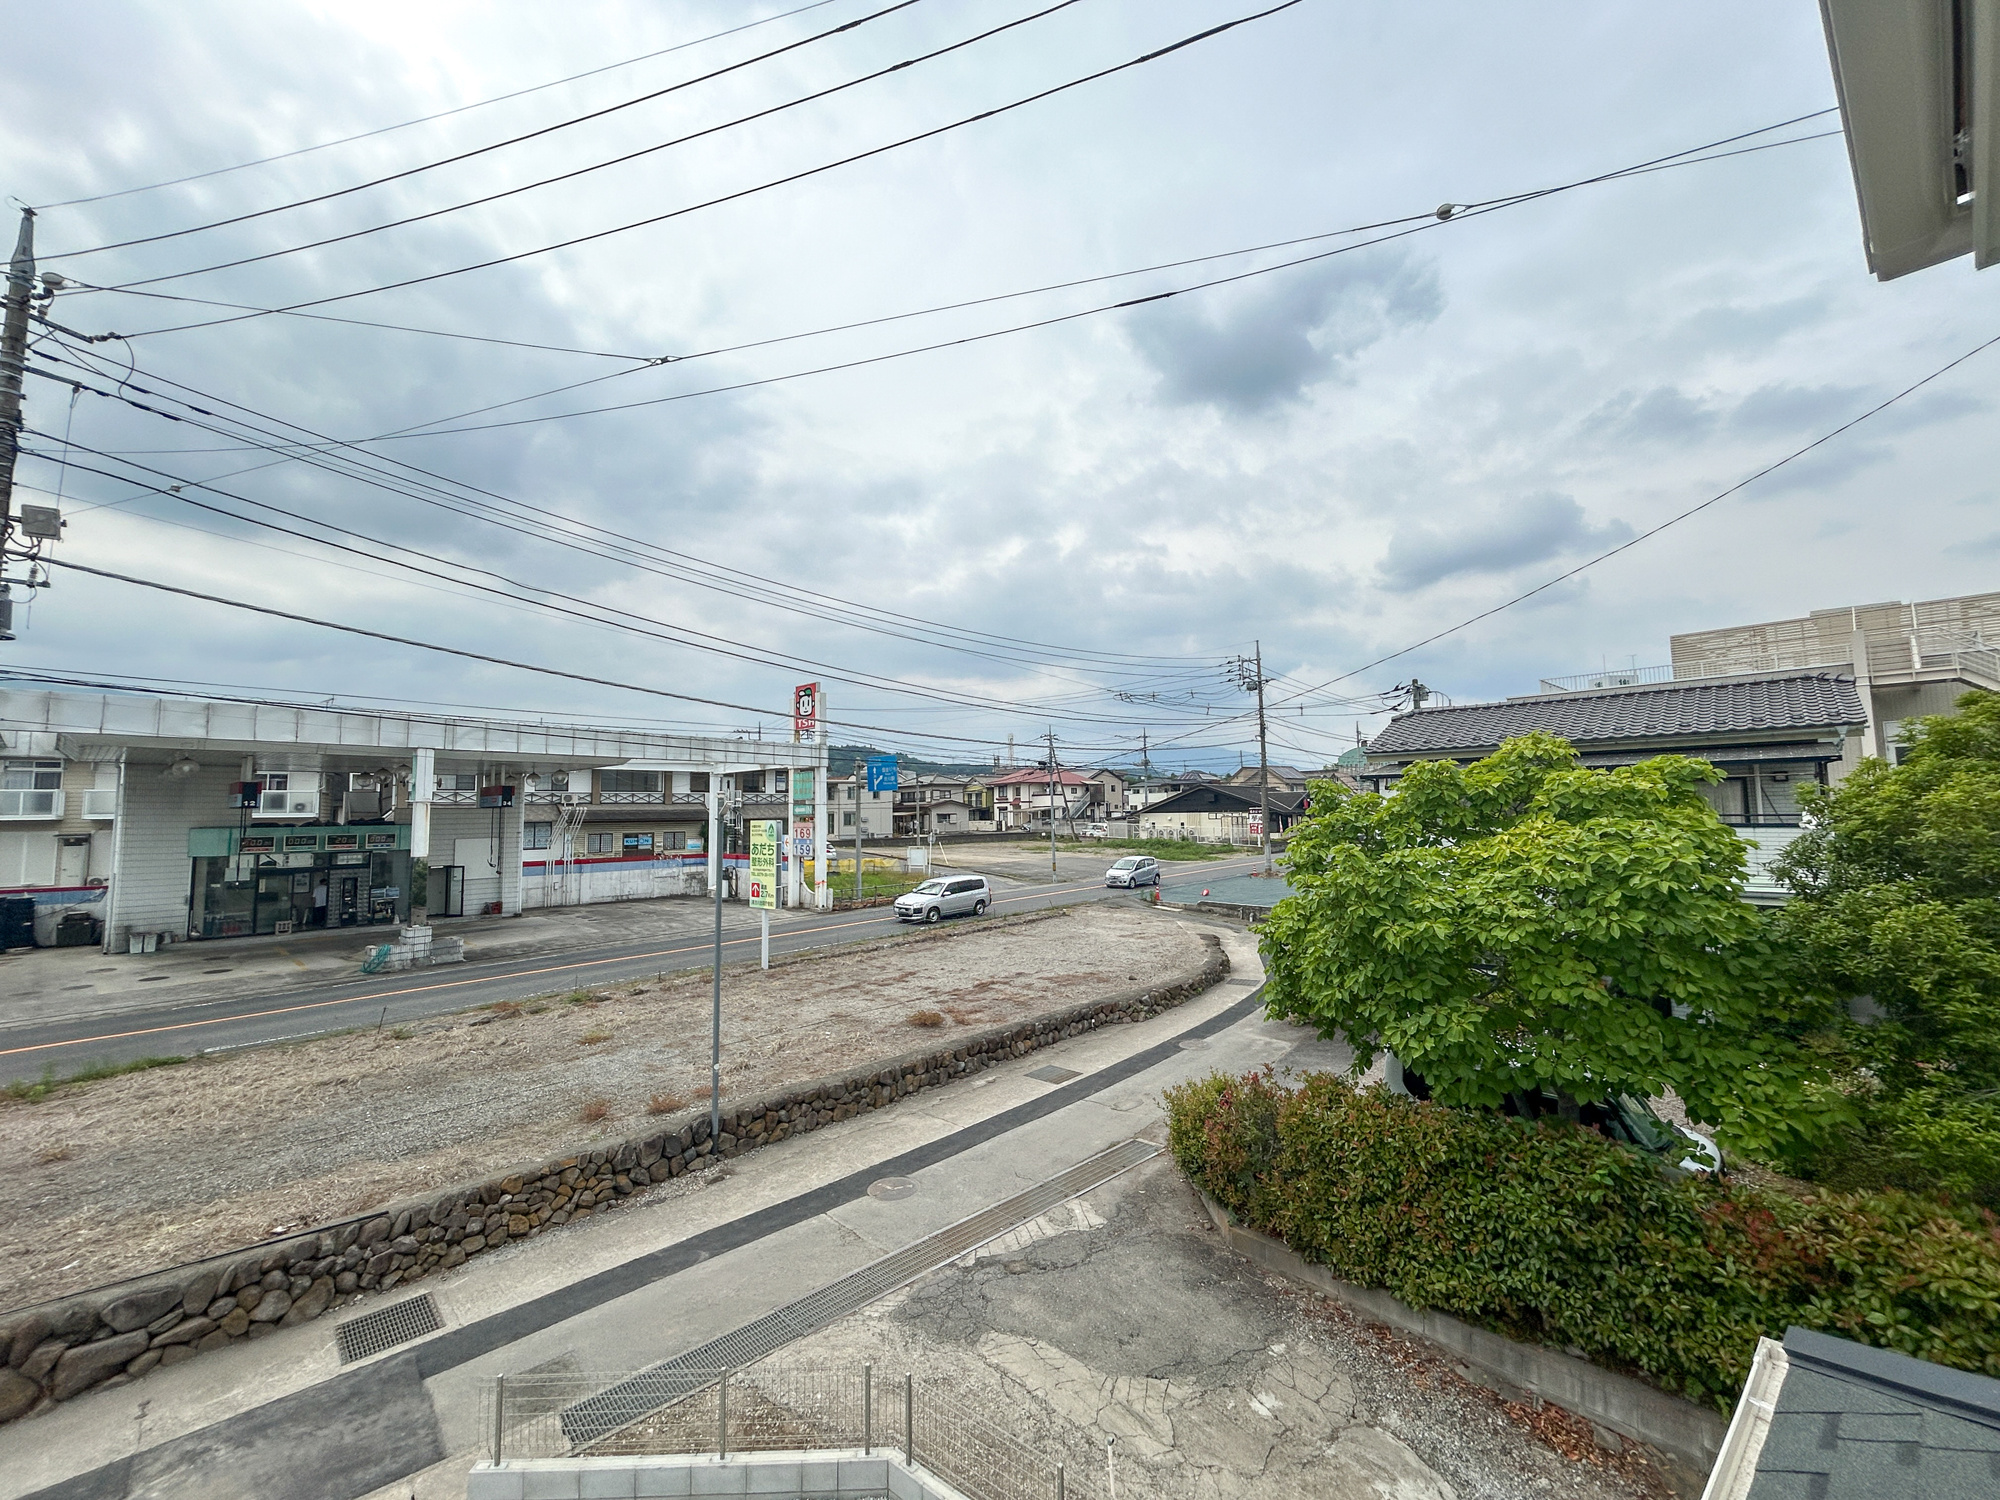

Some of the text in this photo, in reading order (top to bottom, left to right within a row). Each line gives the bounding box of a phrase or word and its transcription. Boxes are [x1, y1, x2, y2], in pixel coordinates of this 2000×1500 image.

[794, 828, 811, 839] 169
[751, 843, 775, 856] あだち
[794, 845, 811, 855] 159
[751, 857, 775, 867] 整形外科
